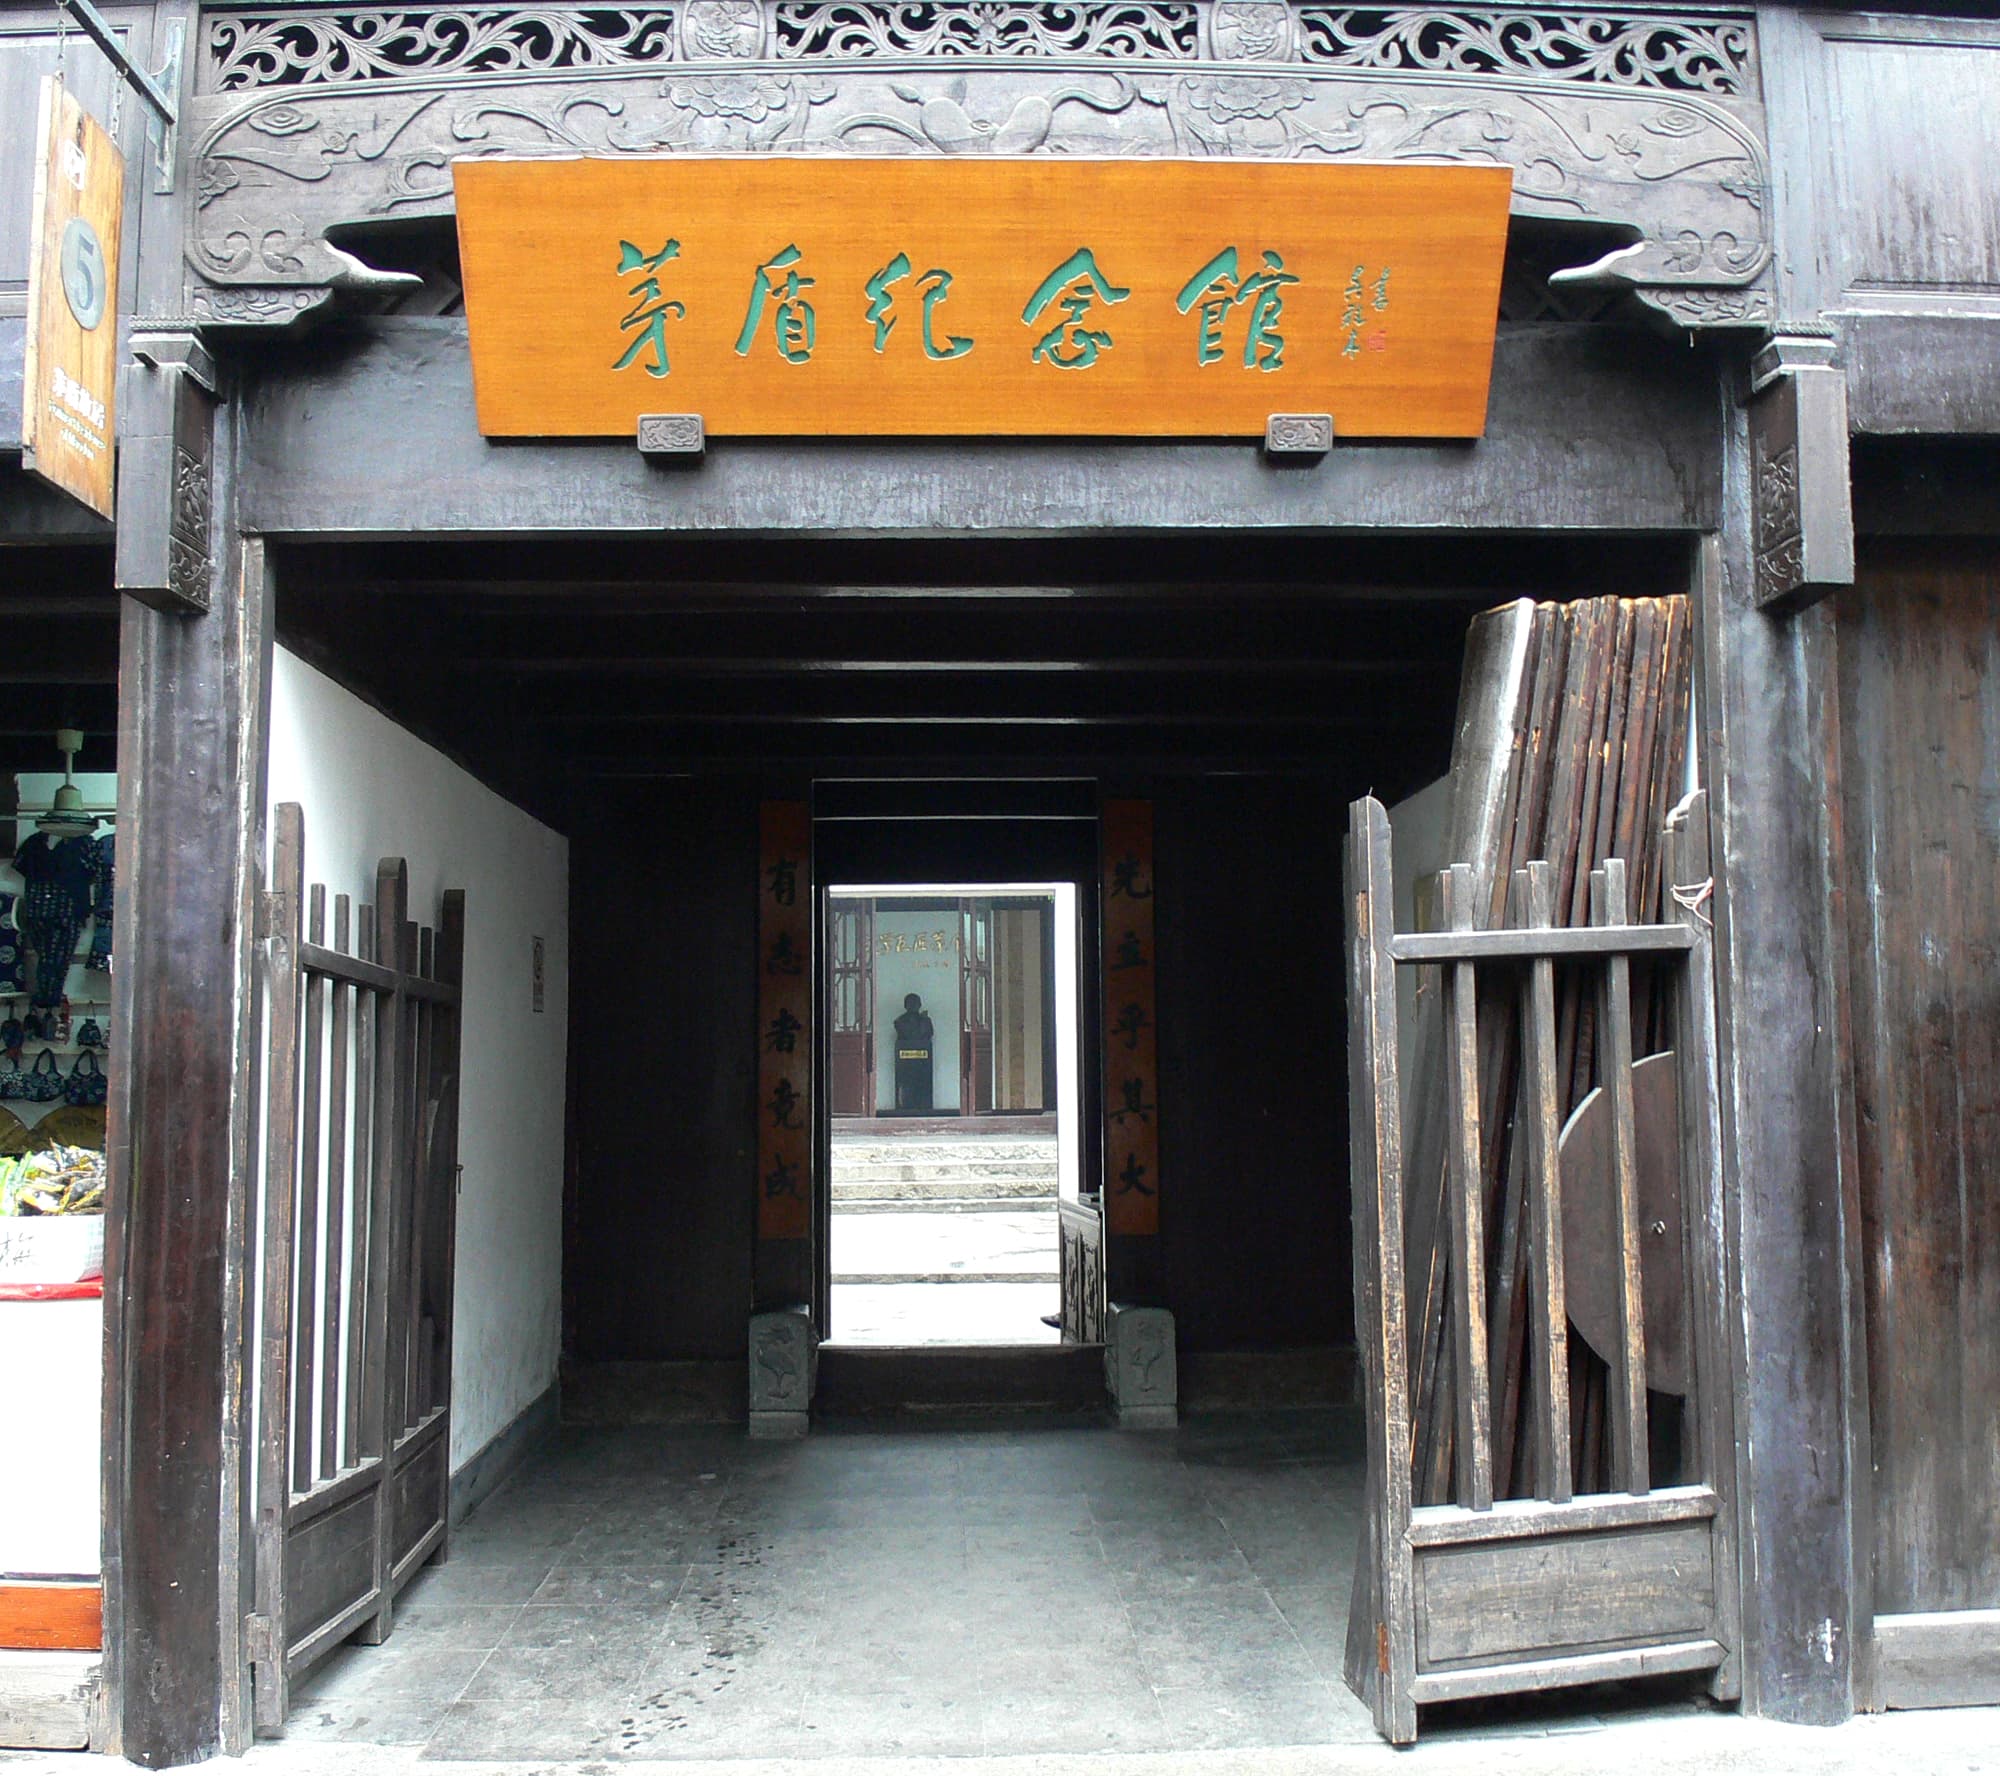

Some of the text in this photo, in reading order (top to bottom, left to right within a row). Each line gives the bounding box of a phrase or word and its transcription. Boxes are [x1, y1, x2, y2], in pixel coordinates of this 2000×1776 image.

[75, 232, 95, 311] 5
[765, 859, 804, 1201] 有志者竟成
